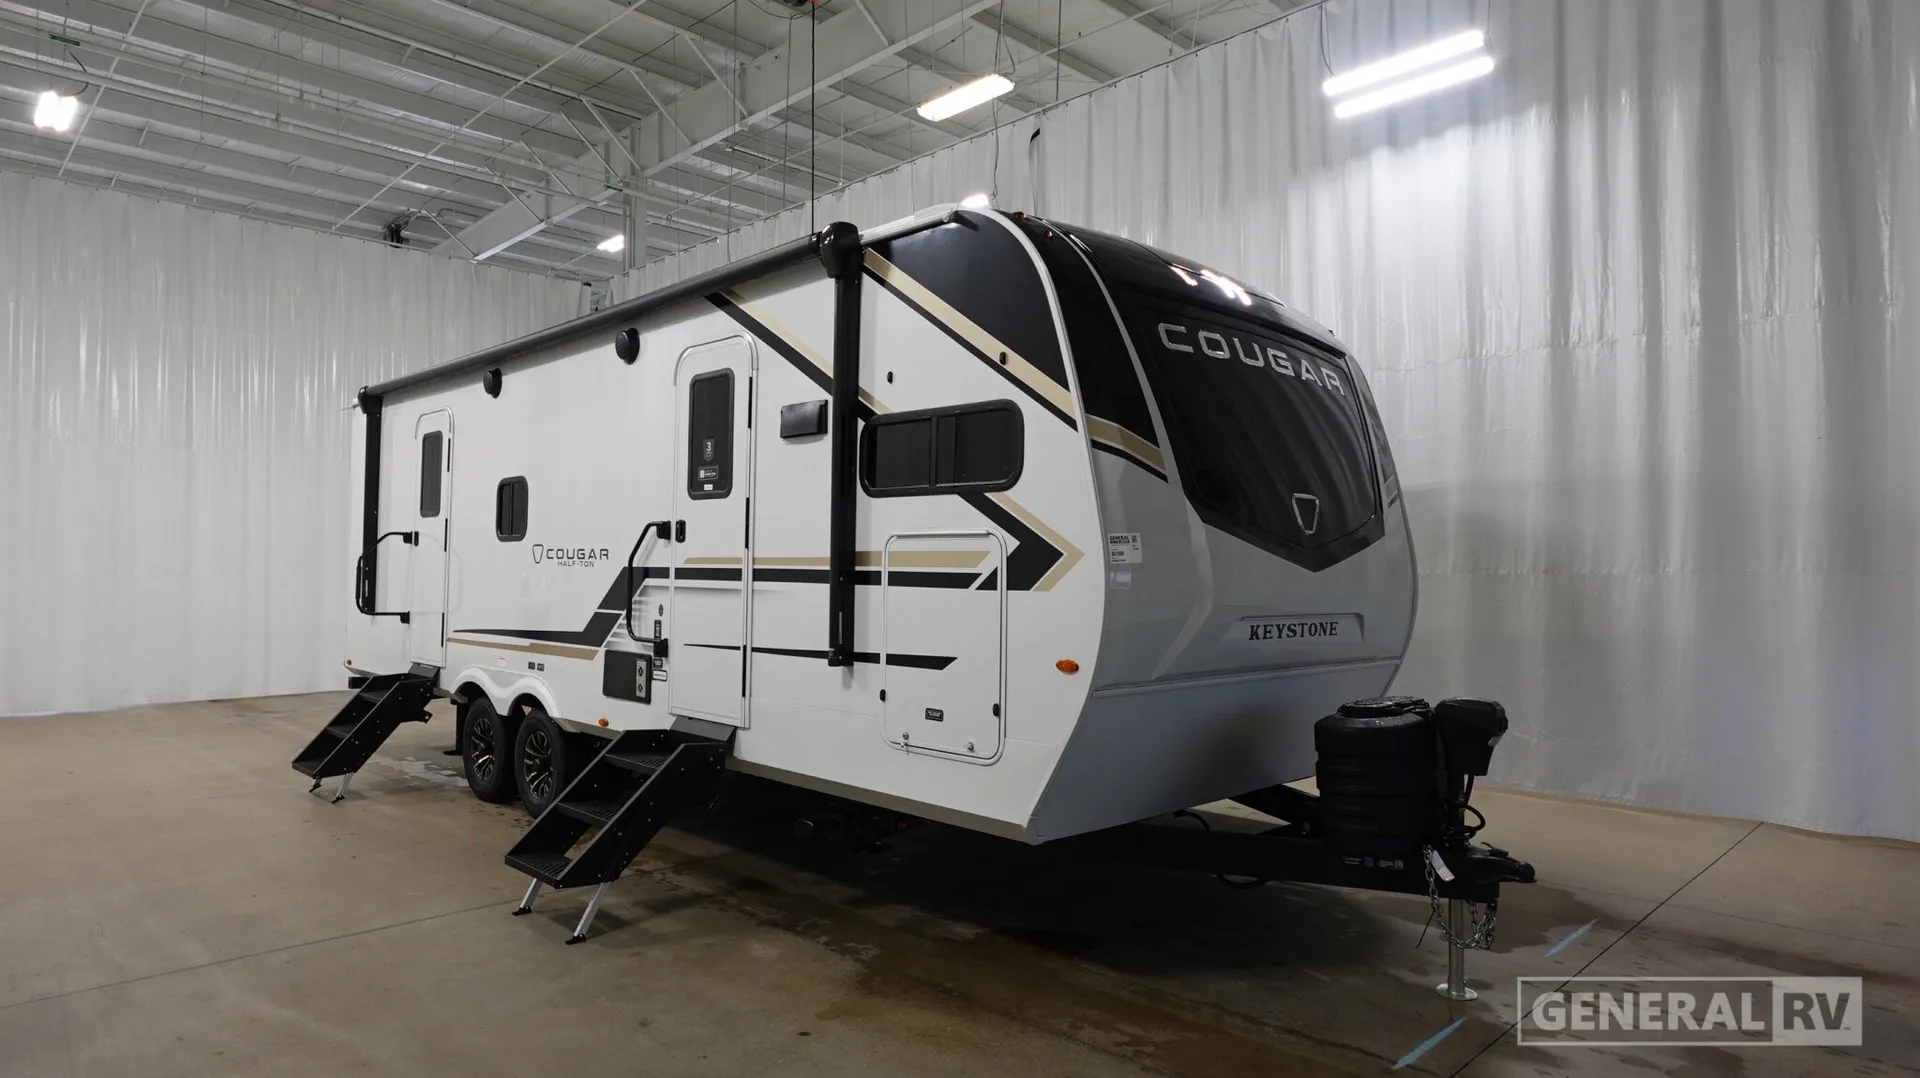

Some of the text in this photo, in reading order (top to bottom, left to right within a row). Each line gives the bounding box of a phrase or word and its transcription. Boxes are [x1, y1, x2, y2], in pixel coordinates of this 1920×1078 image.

[1158, 322, 1345, 396] COUGAR
[706, 441, 712, 452] 3
[546, 548, 609, 560] COUGAR
[557, 560, 595, 568] HALF-TON
[1248, 621, 1339, 641] KEYSTONE
